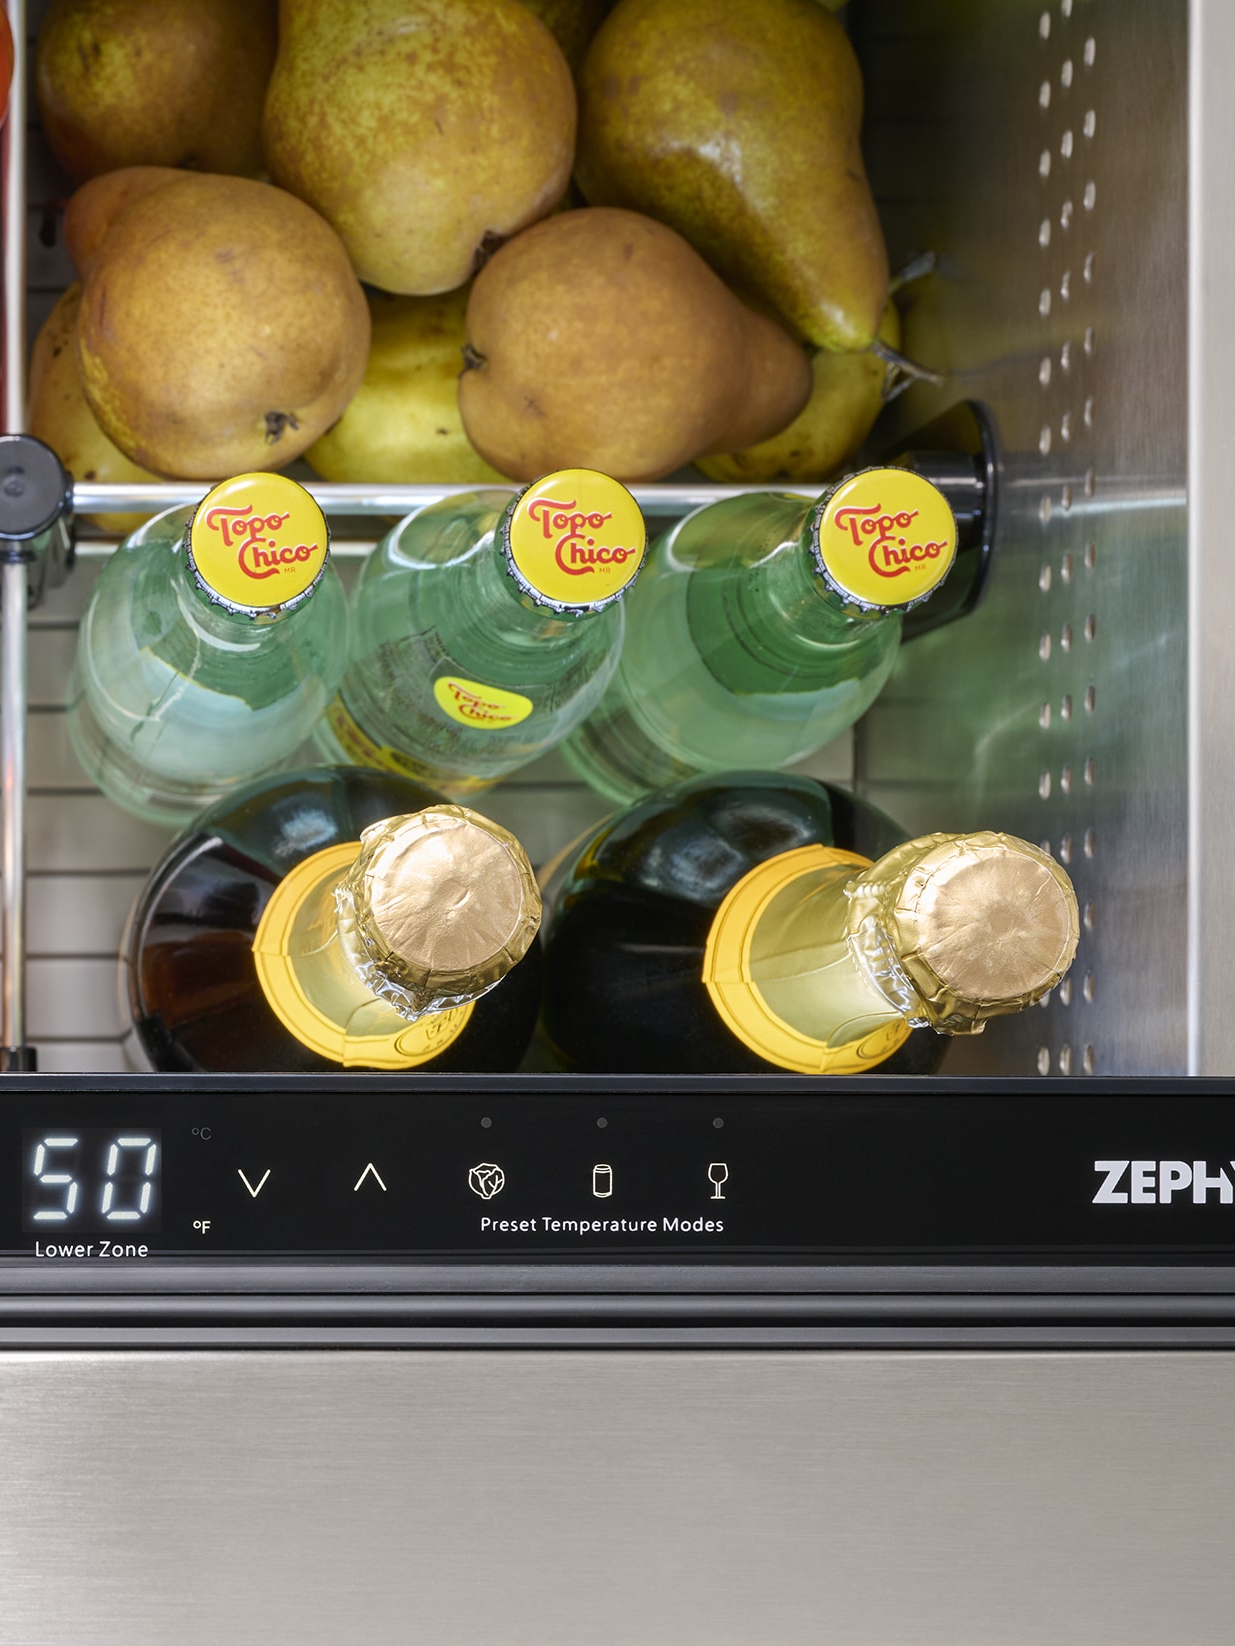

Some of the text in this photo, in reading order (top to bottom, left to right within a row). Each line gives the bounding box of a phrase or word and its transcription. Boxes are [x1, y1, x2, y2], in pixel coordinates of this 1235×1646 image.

[206, 504, 290, 547] Topo
[529, 499, 612, 539] Topo
[834, 503, 919, 546] Topo
[238, 537, 318, 580] Chico
[555, 533, 636, 576] Chico
[868, 536, 948, 578] Chico
[33, 1137, 157, 1221] 50
[1091, 1160, 1235, 1204] ZEPH
[481, 1217, 724, 1235] Preset Temperature Modes
[35, 1241, 149, 1258] Lower Zone
